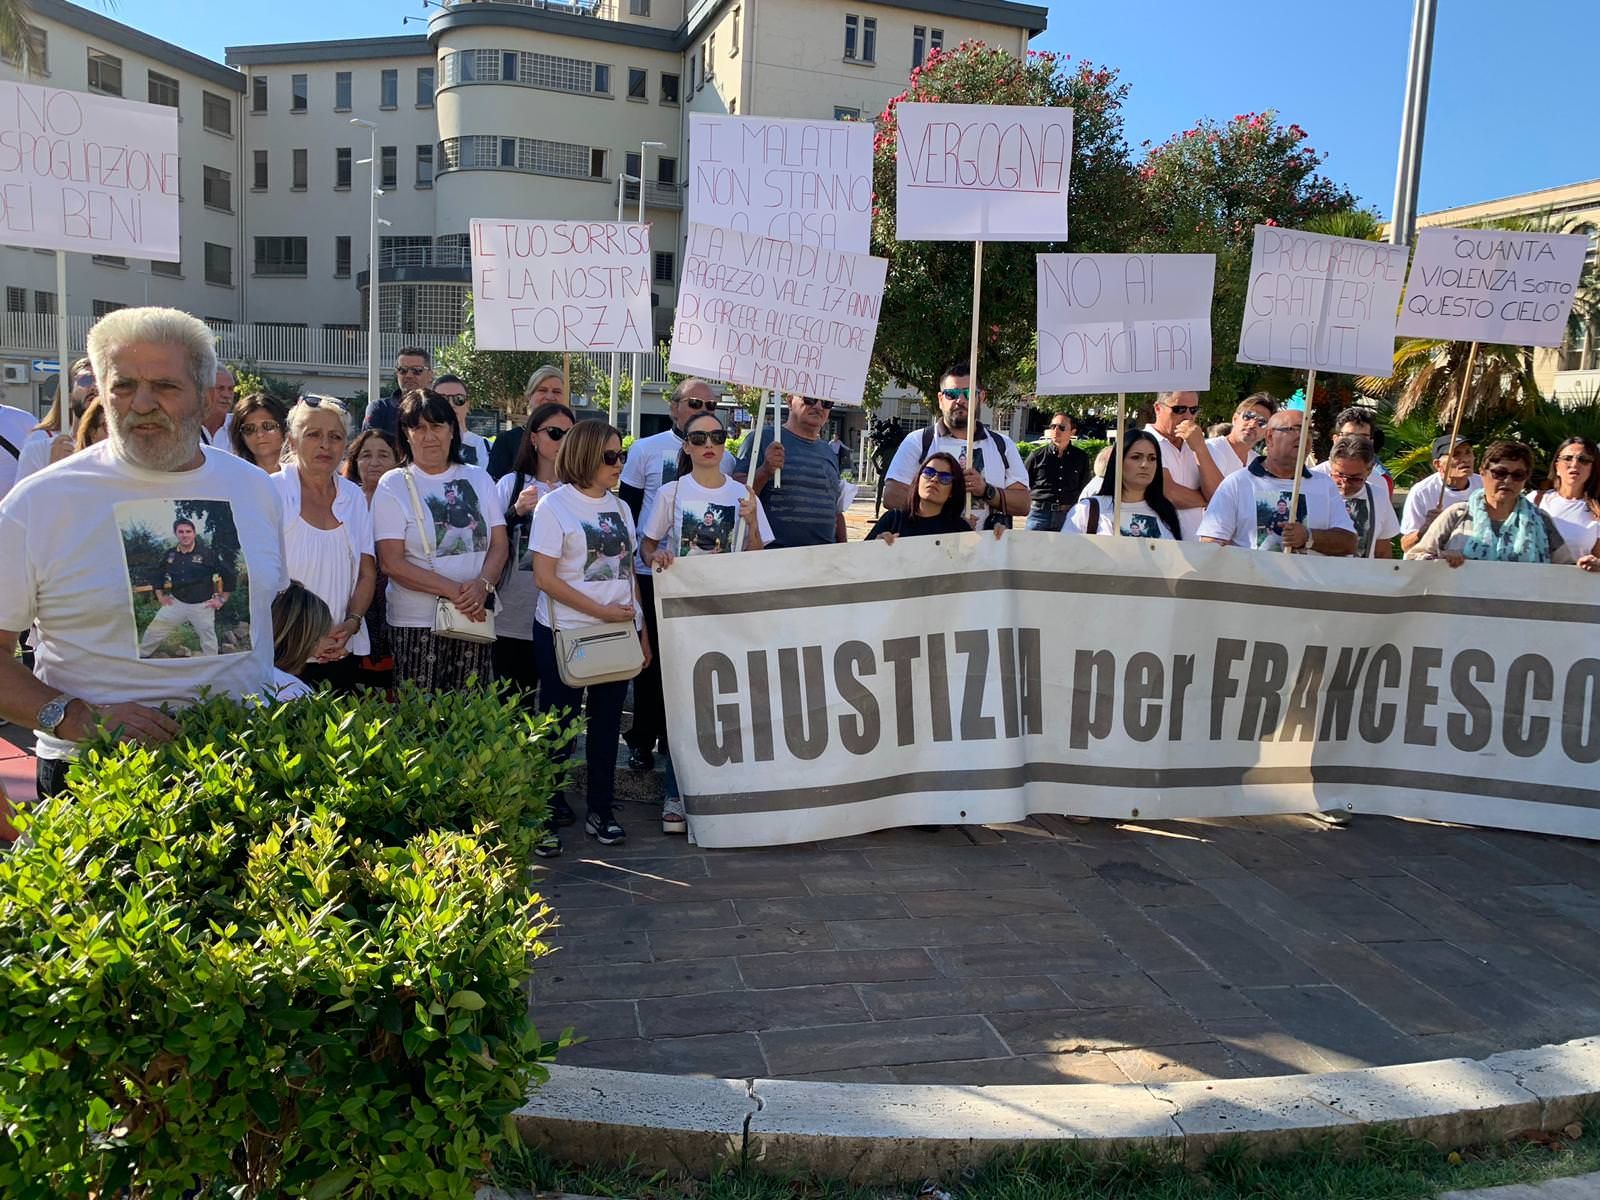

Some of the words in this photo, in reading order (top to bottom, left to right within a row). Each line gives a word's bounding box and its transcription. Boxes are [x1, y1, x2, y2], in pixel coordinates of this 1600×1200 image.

[16, 86, 83, 136] NO
[699, 123, 722, 162] I
[742, 123, 850, 168] MALATI
[897, 122, 1065, 190] VERGOGNA
[0, 181, 35, 232] EI
[62, 187, 143, 244] BENI
[697, 165, 750, 206] NON
[764, 169, 871, 212] STANNO
[472, 223, 496, 257] IL
[497, 224, 548, 259] TUO
[551, 223, 652, 256] SORRISO
[691, 223, 724, 261] LA
[740, 232, 793, 274] VITA
[797, 244, 818, 279] DI
[826, 252, 857, 287] UN
[1262, 230, 1400, 281] PROCURATORE
[481, 269, 495, 300] E
[507, 268, 539, 300] LA
[552, 266, 650, 300] NOSTRA
[685, 257, 764, 297] RAGAZZO
[773, 276, 815, 307] VALE
[819, 286, 847, 312] 17
[847, 291, 881, 320] ANNI
[1043, 256, 1101, 309] NO
[1125, 254, 1155, 304] AI
[1251, 271, 1375, 321] GRATTERI
[1421, 265, 1517, 292] VIOLENZA
[511, 305, 643, 350] FORZA
[682, 293, 701, 321] DI
[704, 298, 760, 331] CARCERE
[1407, 294, 1494, 319] QUESTO
[678, 322, 703, 345] ED
[727, 328, 824, 369] DOMICILIARI
[1038, 322, 1192, 375] DOMICILIARI
[1243, 318, 1273, 361] CI
[1289, 320, 1361, 368] AIUTI
[718, 354, 742, 383] AL
[752, 362, 846, 400] MANDANTE
[693, 627, 1043, 767] GIUSTIZIA
[1069, 648, 1196, 750] per
[1209, 637, 1600, 764] FRANCESCO
